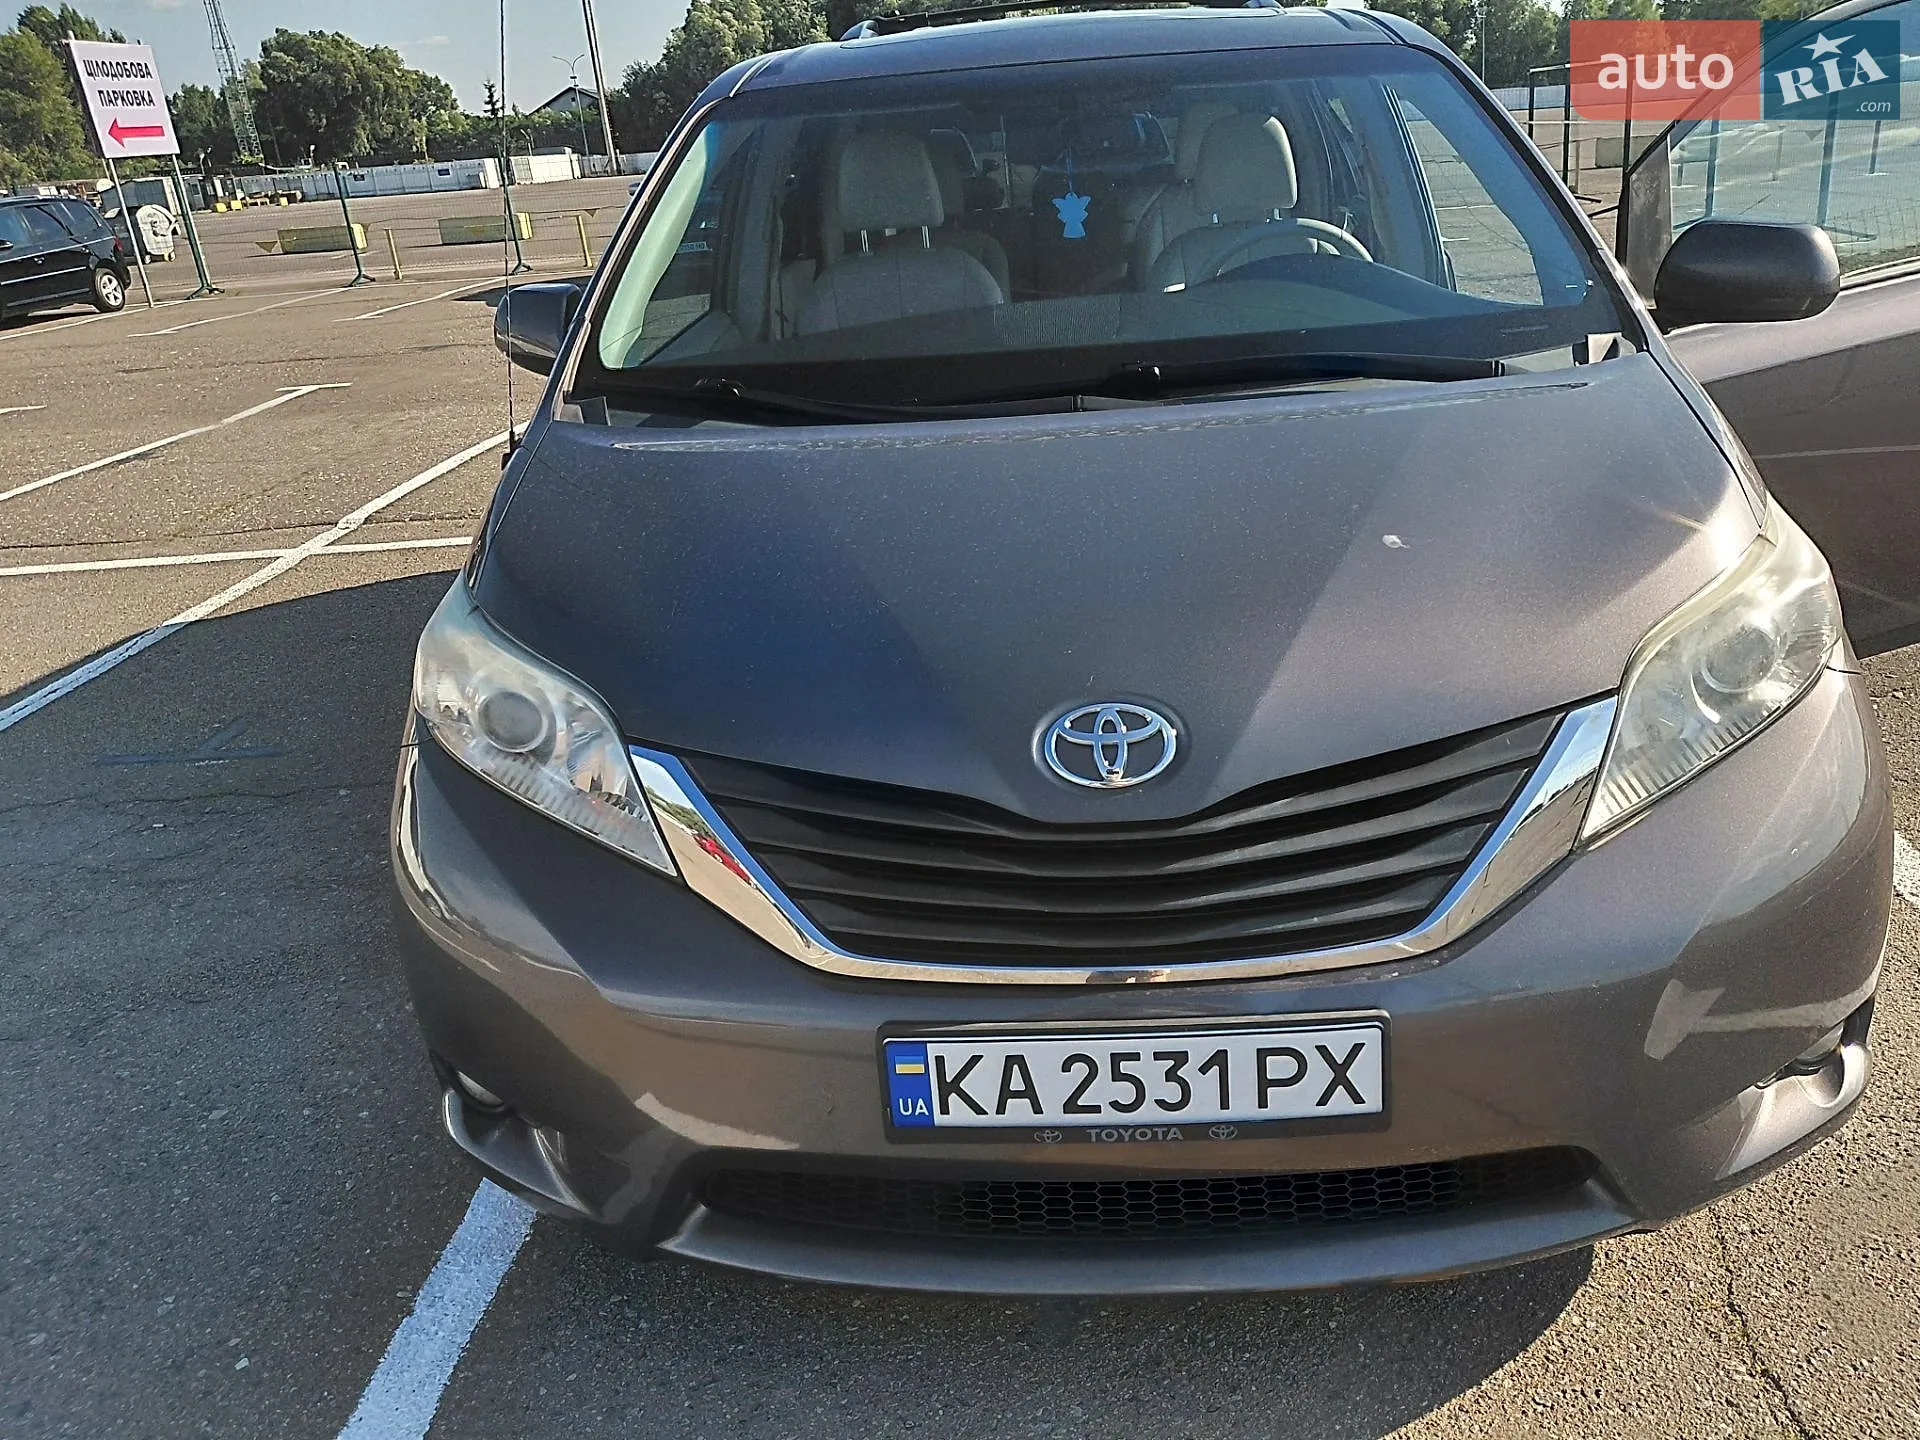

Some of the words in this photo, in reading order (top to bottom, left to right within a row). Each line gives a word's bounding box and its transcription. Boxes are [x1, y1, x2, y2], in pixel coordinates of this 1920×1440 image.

[83, 59, 153, 81] ЦІЛОДОБОВА
[97, 89, 156, 107] ПАРКОВКА
[1061, 1048, 1231, 1114] 2531
[898, 1097, 929, 1116] UA
[1086, 1127, 1185, 1143] TOYOTA
